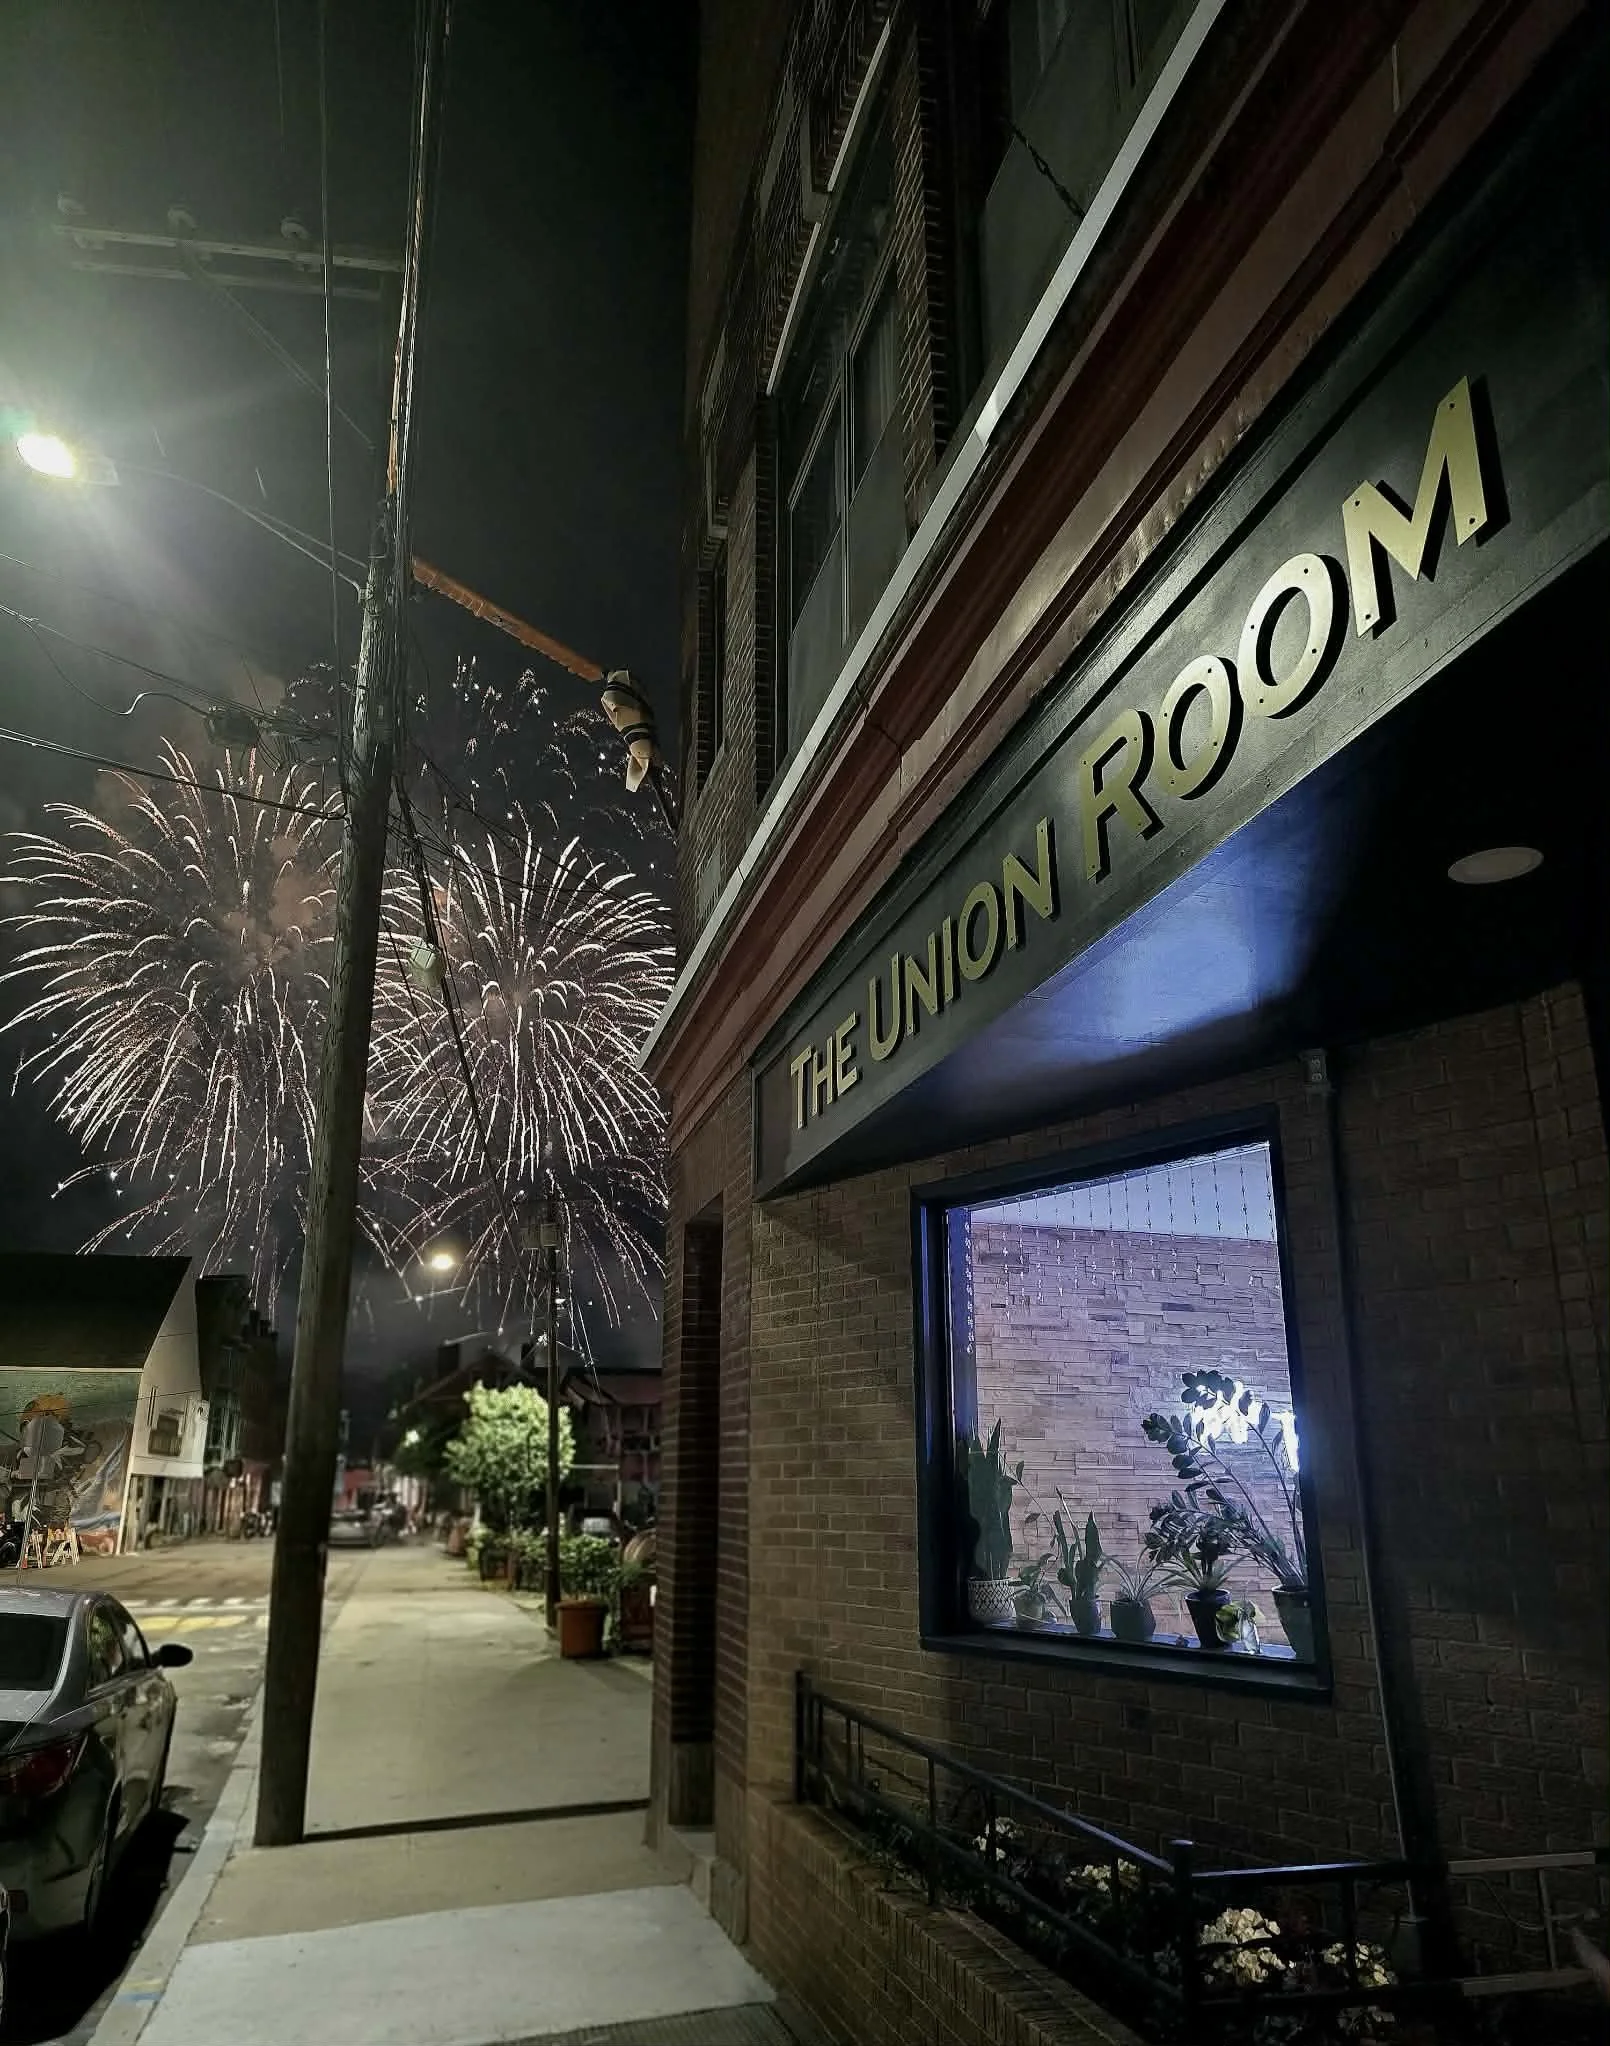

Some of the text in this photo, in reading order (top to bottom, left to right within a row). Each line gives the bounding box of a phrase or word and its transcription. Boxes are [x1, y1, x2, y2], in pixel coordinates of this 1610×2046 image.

[790, 376, 1488, 1129] THE UNION ROOM
